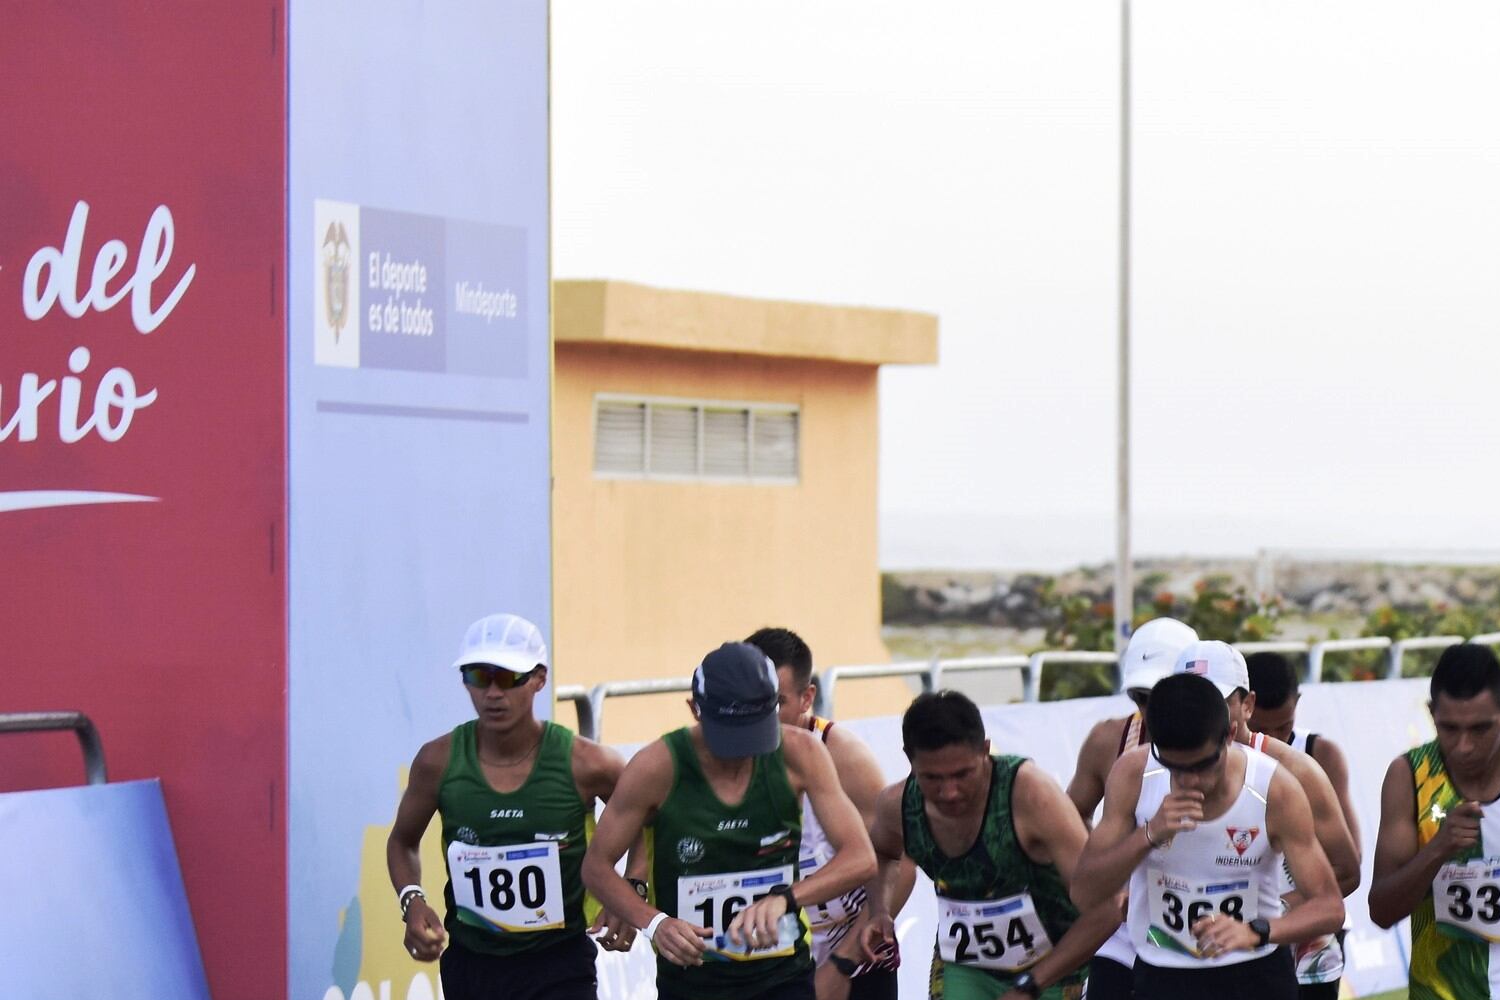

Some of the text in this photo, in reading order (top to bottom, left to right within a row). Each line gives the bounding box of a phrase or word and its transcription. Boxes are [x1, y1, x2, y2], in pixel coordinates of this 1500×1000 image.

[23, 199, 197, 335] del
[368, 251, 427, 300] El deporte
[368, 295, 434, 336] es de todos
[455, 280, 517, 325] Mindeporte
[0, 346, 158, 443] rio
[490, 808, 524, 819] SAETA
[716, 818, 749, 831] SAETA
[464, 865, 547, 911] 180
[694, 892, 773, 939] 16
[948, 916, 1035, 964] 254
